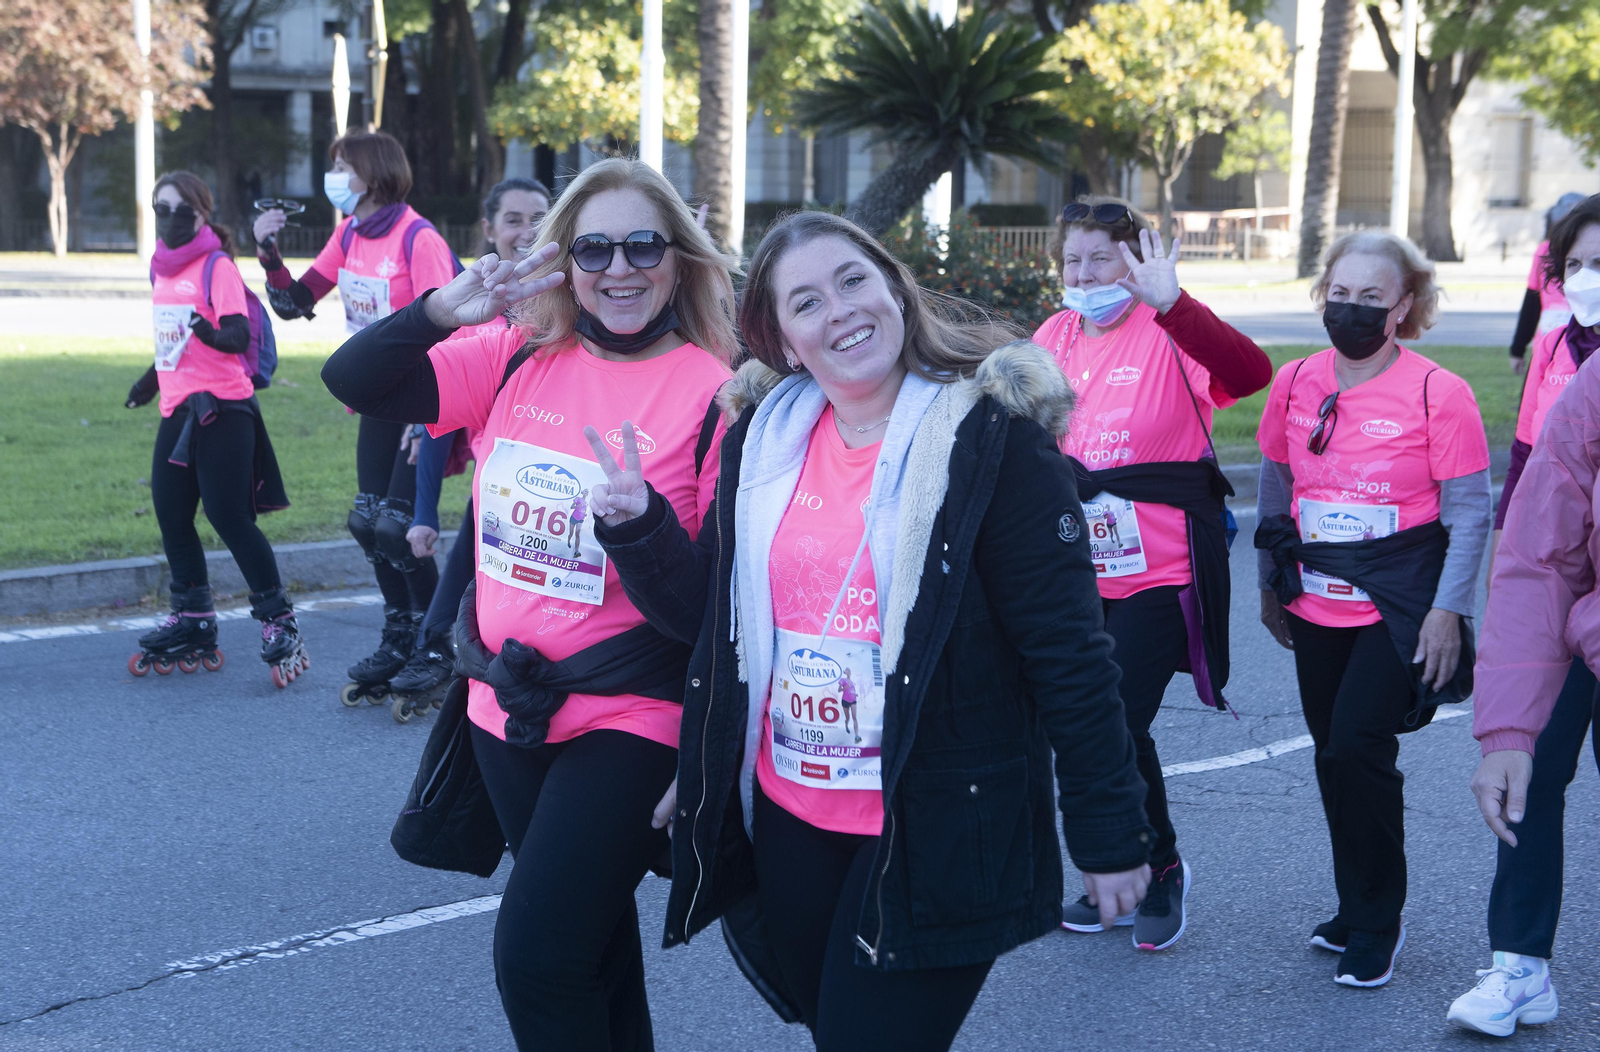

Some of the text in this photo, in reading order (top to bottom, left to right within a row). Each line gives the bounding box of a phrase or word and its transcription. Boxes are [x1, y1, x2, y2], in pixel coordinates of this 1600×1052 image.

[159, 331, 180, 344] 016
[1549, 374, 1575, 386] OYS
[1100, 430, 1130, 445] POR
[1083, 447, 1129, 463] TODAS
[519, 469, 575, 496] ASTURIANA
[1357, 481, 1391, 494] POR
[511, 500, 568, 536] 016
[1320, 519, 1363, 532] ASTURIANA
[519, 533, 548, 551] 1200
[498, 540, 579, 570] CARRERA DE LA MUJER
[1103, 550, 1125, 559] MUJER
[484, 553, 508, 573] OYSHO
[1118, 561, 1139, 569] ZURICH
[520, 570, 542, 581] Santander
[564, 581, 594, 592] ZURICH
[847, 586, 877, 606] PO
[823, 612, 880, 633] ODA
[790, 692, 840, 724] 016
[799, 727, 824, 744] 1199
[806, 744, 816, 755] DE
[816, 746, 828, 756] LA
[829, 747, 862, 758] MUJER
[775, 753, 799, 772] OYSHO
